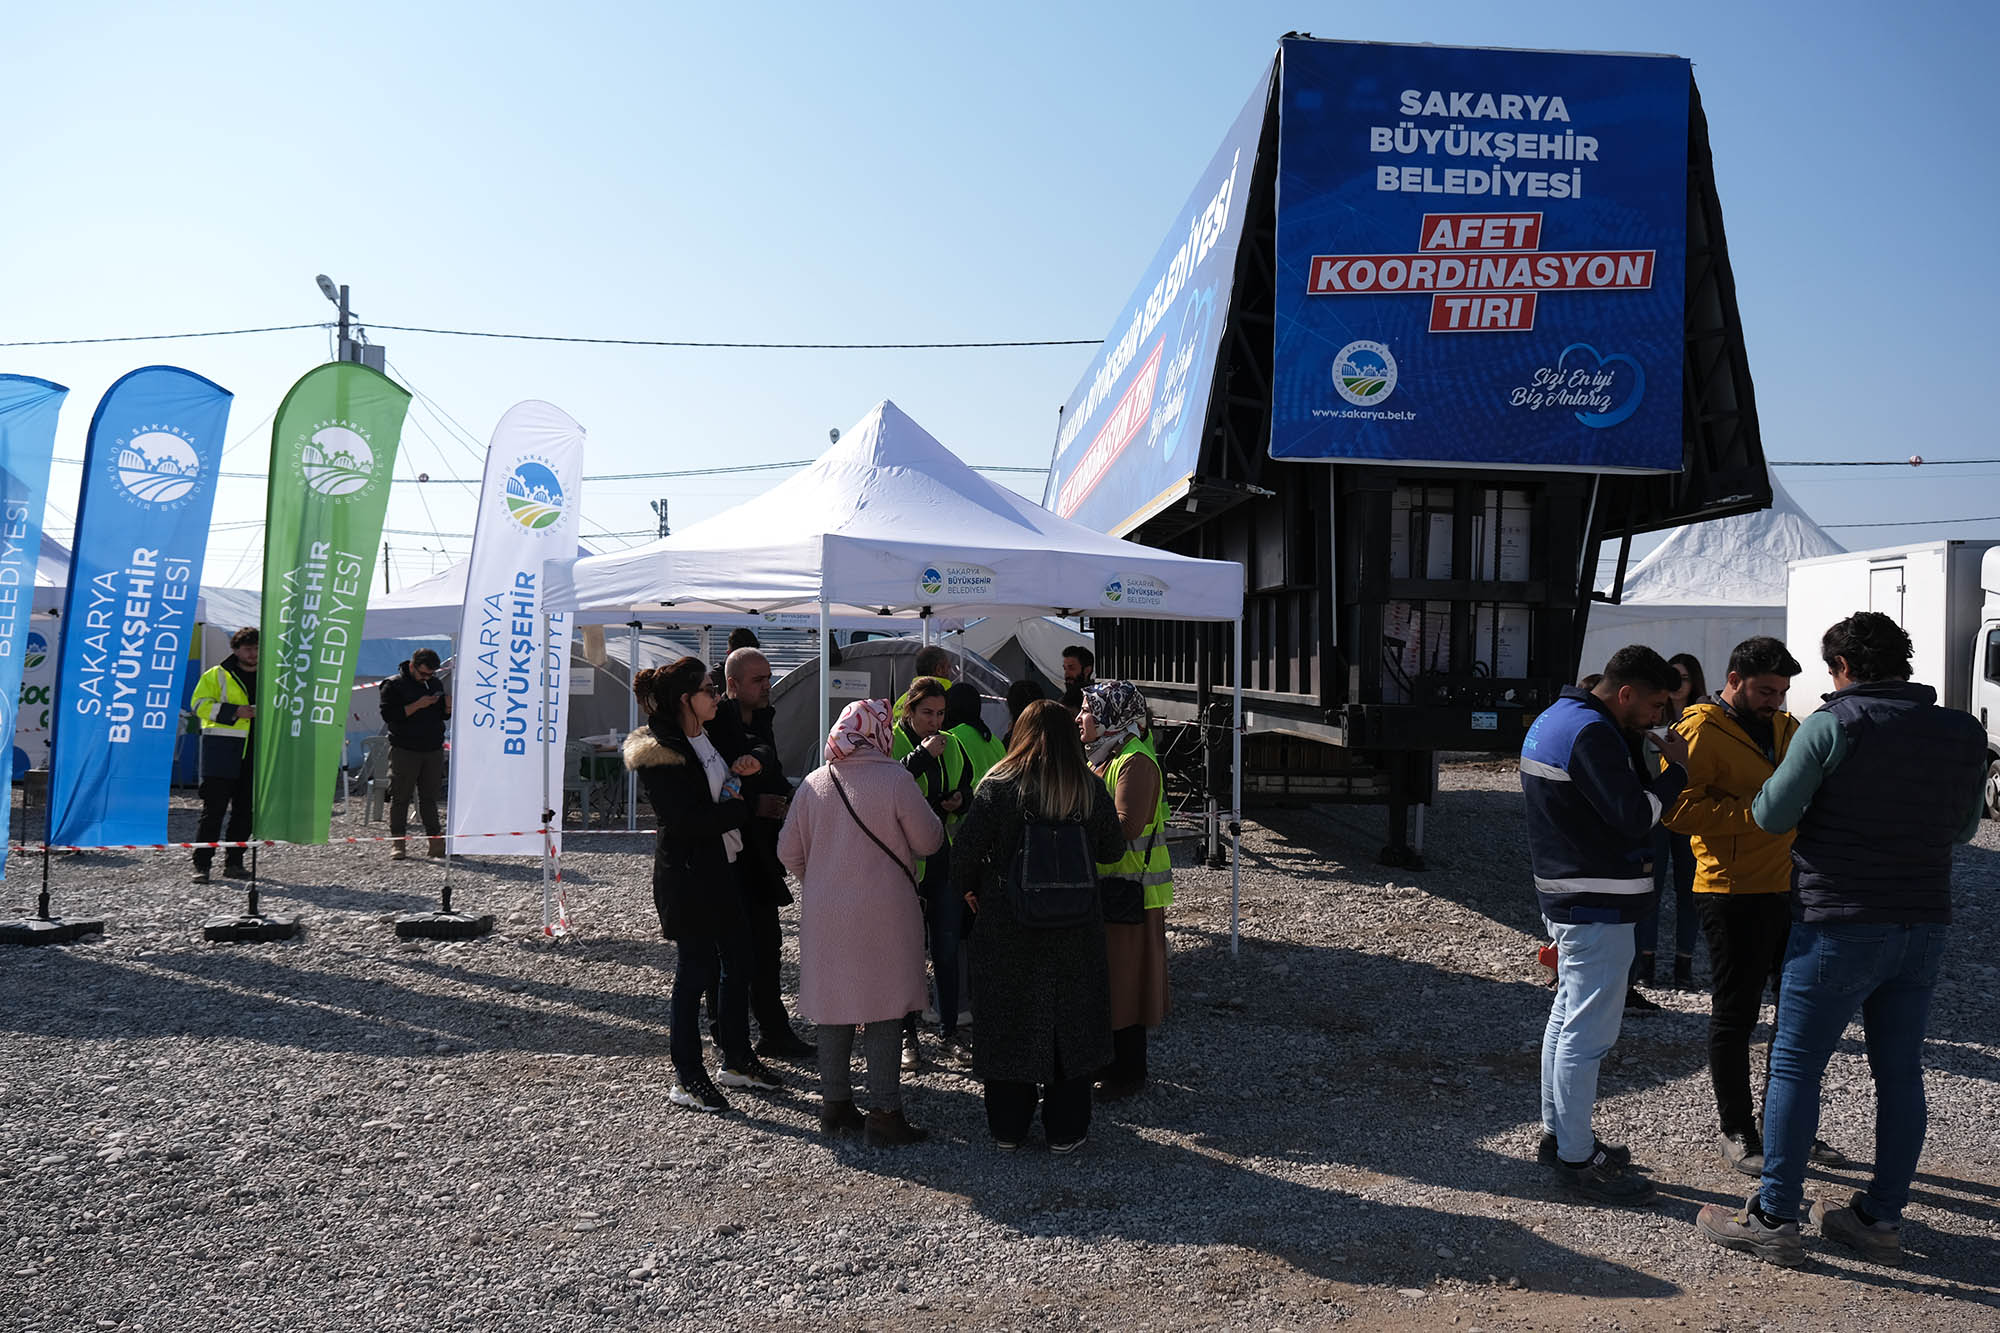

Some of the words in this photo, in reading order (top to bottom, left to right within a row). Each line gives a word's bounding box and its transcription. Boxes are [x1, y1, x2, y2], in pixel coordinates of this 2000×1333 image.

[1370, 122, 1599, 163] BÜYÜKŞEHİR
[1400, 89, 1570, 122] SAKARYA
[1376, 164, 1582, 199] BELEDİYESİ
[1426, 217, 1534, 249] AFET
[1139, 147, 1240, 348] BELEDİYESİ
[1445, 297, 1522, 329] TIRI
[132, 424, 195, 443] SAKARYA
[1312, 409, 1416, 420] www.sakarya.bel.tr
[1508, 387, 1545, 410] Biz
[1531, 368, 1567, 390] Sizi
[1567, 369, 1591, 388] En
[77, 571, 119, 715] SAKARYA
[105, 547, 159, 743] BÜYÜKŞEHİR
[142, 557, 192, 730] BELEDİYESİ
[273, 566, 301, 709] SAKARYA
[290, 541, 330, 737] BÜYÜKŞEHİR
[310, 550, 363, 725] BELEDİYESİ
[473, 592, 504, 728] SAKARYA
[500, 571, 536, 755] BÜYÜKŞEHİR
[537, 612, 564, 743] BELEDİYE
